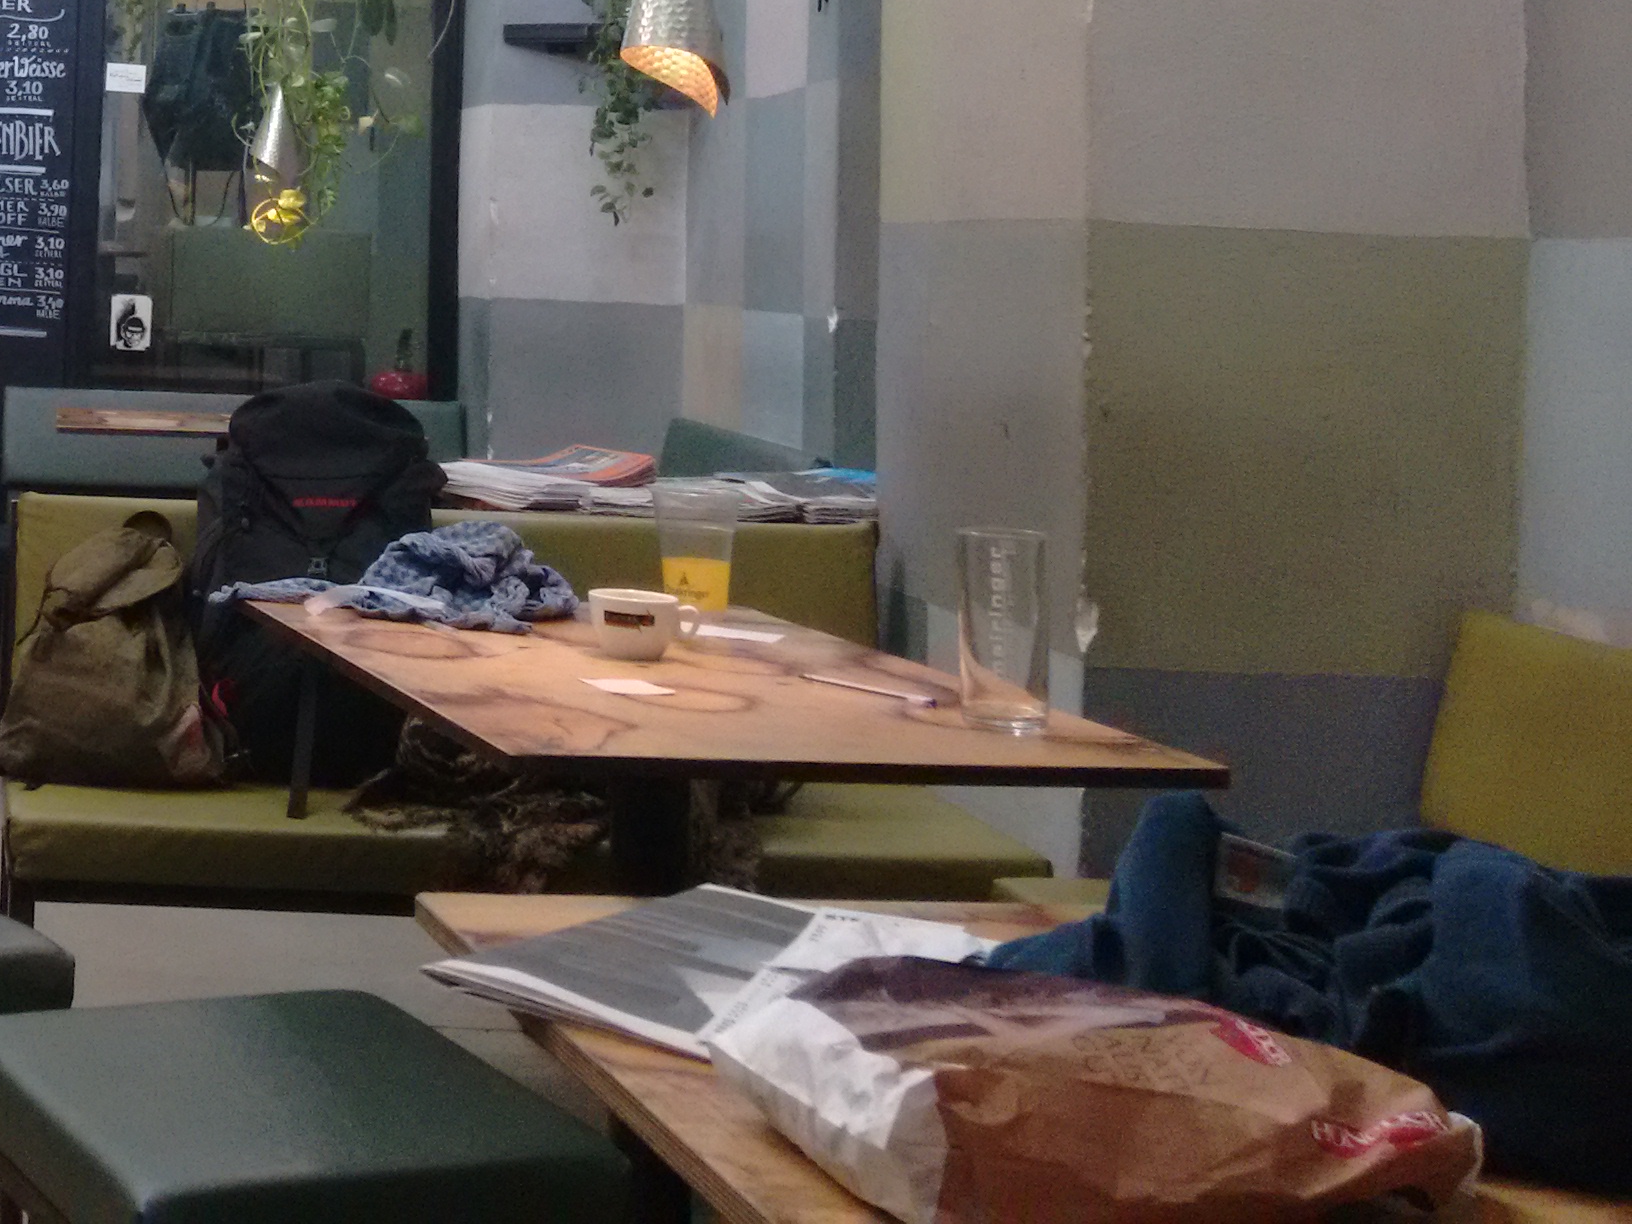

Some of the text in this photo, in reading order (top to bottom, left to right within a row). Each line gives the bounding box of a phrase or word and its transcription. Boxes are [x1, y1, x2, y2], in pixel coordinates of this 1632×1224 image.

[6, 23, 50, 42] 2,80
[13, 54, 67, 79] Weisse
[4, 80, 44, 97] 3,10
[39, 178, 70, 192] 3,60
[37, 201, 68, 217] 3,90
[34, 236, 66, 252] 3,10
[34, 266, 65, 282] 3,10
